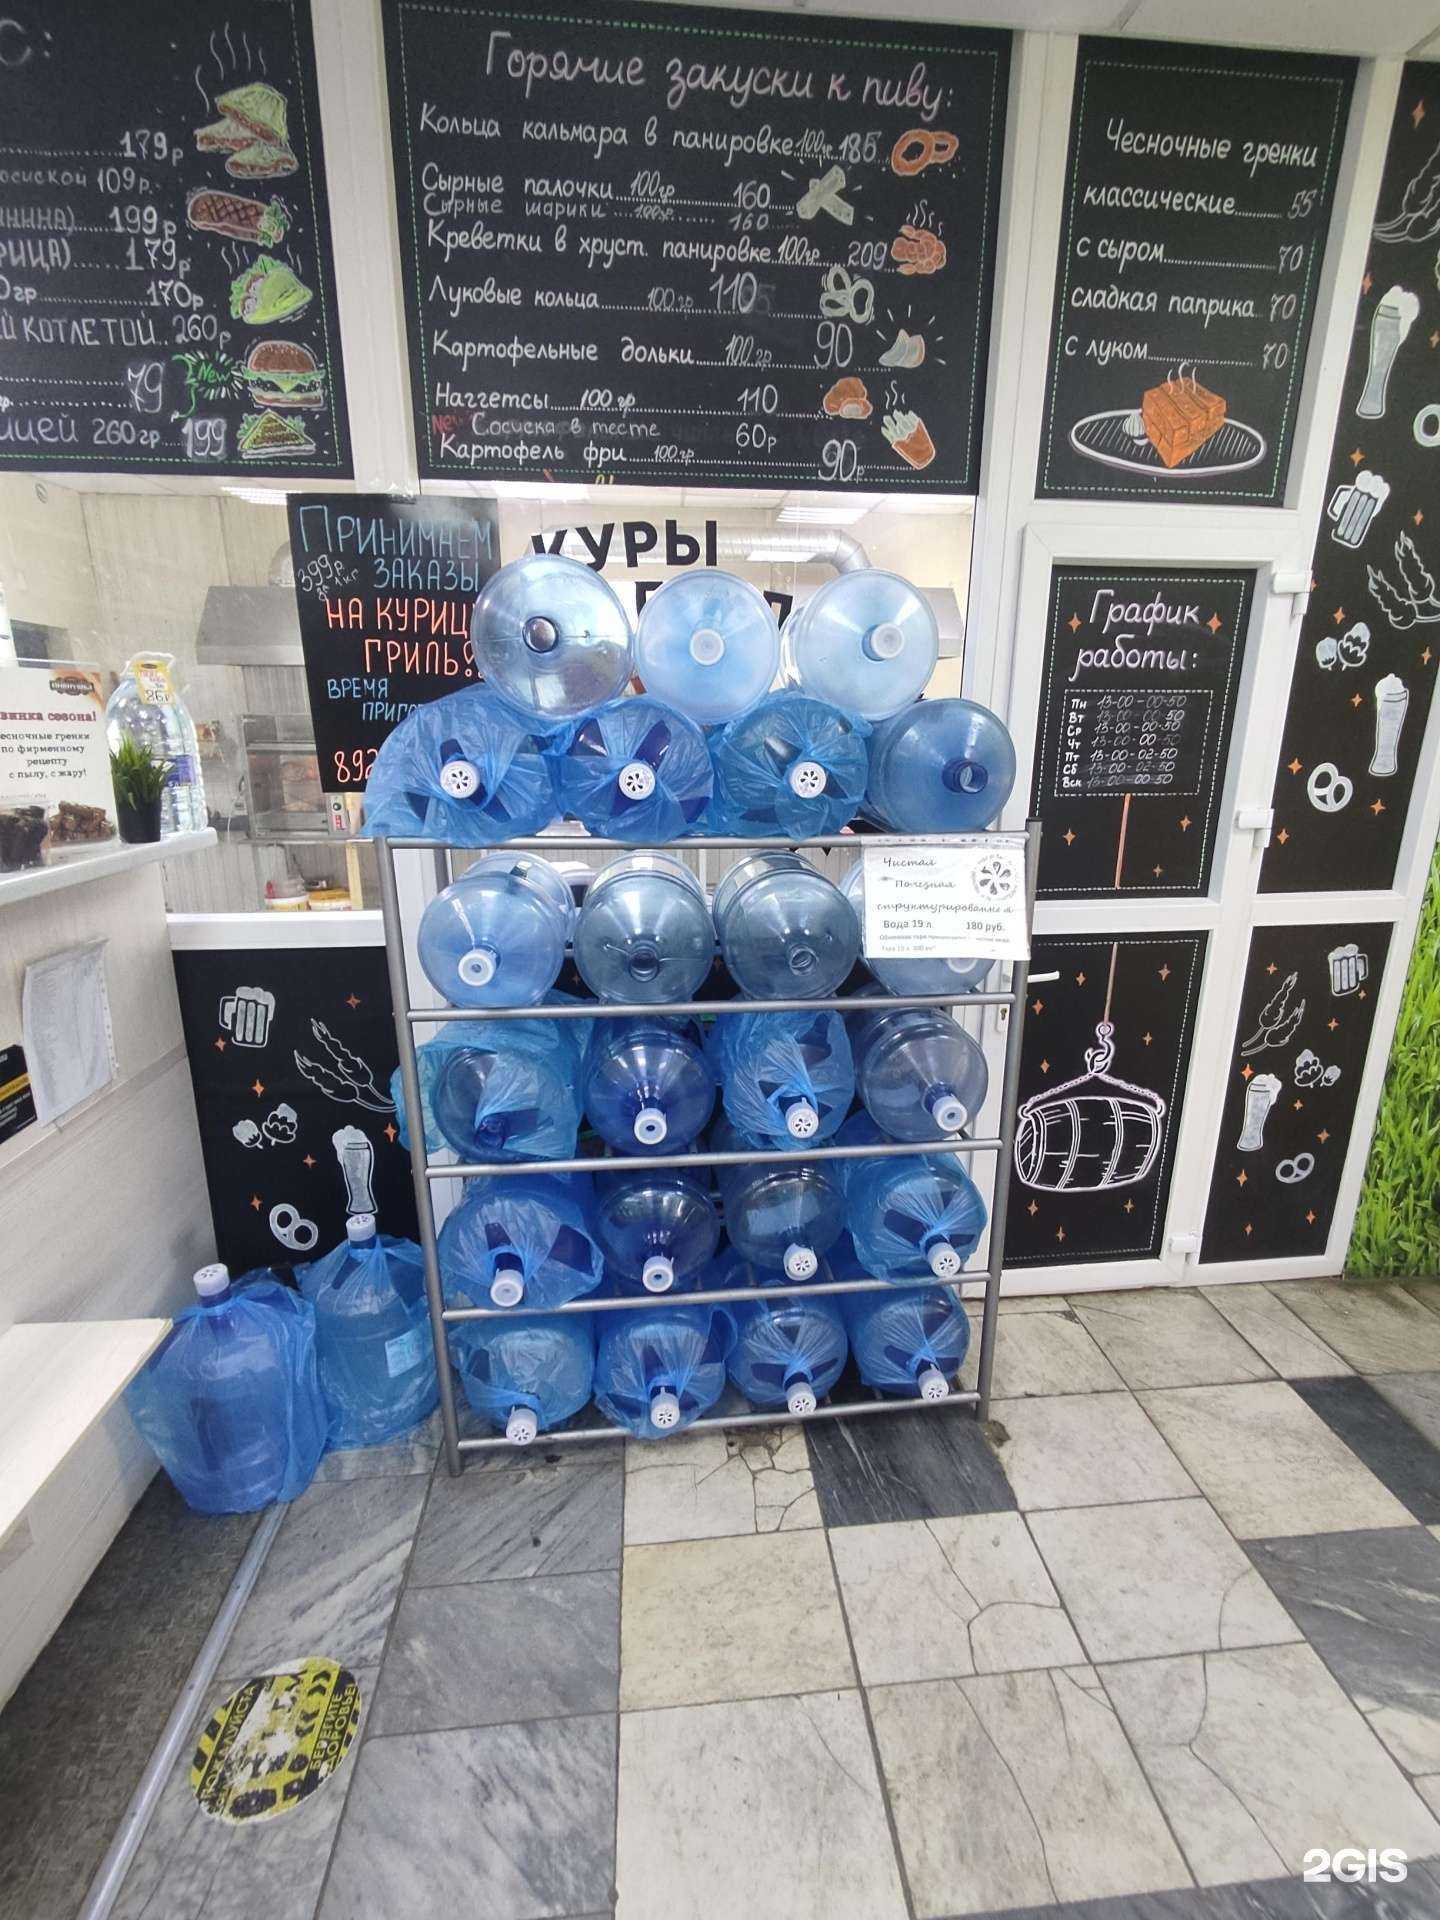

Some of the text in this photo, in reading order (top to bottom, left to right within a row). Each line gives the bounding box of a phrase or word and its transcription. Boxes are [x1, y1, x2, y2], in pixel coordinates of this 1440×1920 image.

[487, 30, 954, 121] Горячие закуски к пиву:
[420, 102, 501, 139] Кольца
[522, 119, 628, 159] кальмара
[644, 115, 658, 146] в
[672, 125, 794, 167] панировке
[1106, 118, 1318, 178] Чесночные гренки
[422, 162, 504, 203] Сырные
[524, 177, 614, 200] палочки
[732, 181, 771, 209] 160
[1084, 184, 1318, 220] классические 55
[423, 193, 504, 219] Сырные
[525, 200, 606, 219] шарики
[728, 213, 769, 231] 160
[428, 219, 543, 262] Креветки
[554, 224, 567, 252] в
[579, 236, 649, 269] хруст.
[662, 236, 770, 272] панировке
[1098, 239, 1164, 274] сыром
[1278, 245, 1304, 274] 70
[428, 275, 522, 317] Луковые
[534, 288, 600, 309] кольца
[1071, 284, 1297, 328] сладкая паприка 70
[23, 310, 157, 347] КОТЛЕТОЙ
[432, 329, 599, 372] Картофельные
[621, 336, 695, 365] дольки
[813, 321, 853, 368] 90
[1086, 339, 1149, 365] луком
[1262, 343, 1288, 370] 70
[435, 382, 549, 410] Наггетсы
[737, 384, 778, 414] 110
[182, 417, 228, 458] 199
[471, 412, 556, 436] Сосиска
[571, 417, 582, 434] в
[592, 420, 661, 438] тесте
[440, 433, 565, 466] Картофель
[583, 440, 627, 467] фри
[374, 558, 479, 592] ЗАКАЗЫ
[326, 597, 476, 639] НА КУРИЦ
[1089, 590, 1200, 635] График
[365, 639, 484, 679] ГРИЛЬ!
[1068, 634, 1200, 682] работы:
[327, 677, 389, 700] ВРЕМЯ
[1072, 699, 1088, 709] Пн
[1067, 725, 1082, 736] Ср
[1069, 712, 1085, 723] Вт
[18, 745, 85, 754] фирменному
[56, 733, 90, 741] гренки
[1068, 738, 1081, 749] Чт
[27, 758, 68, 767] рецепту
[58, 768, 87, 778] жару!
[1063, 763, 1078, 774] Сб
[1065, 751, 1080, 762] Пт
[883, 857, 936, 867] Чистая
[895, 879, 957, 890] Полезная
[883, 919, 909, 929] Вода
[912, 919, 924, 928] 19
[966, 921, 983, 930] 180
[985, 922, 1006, 932] руб.
[309, 1693, 343, 1770] БЕРЕГИТЕ
